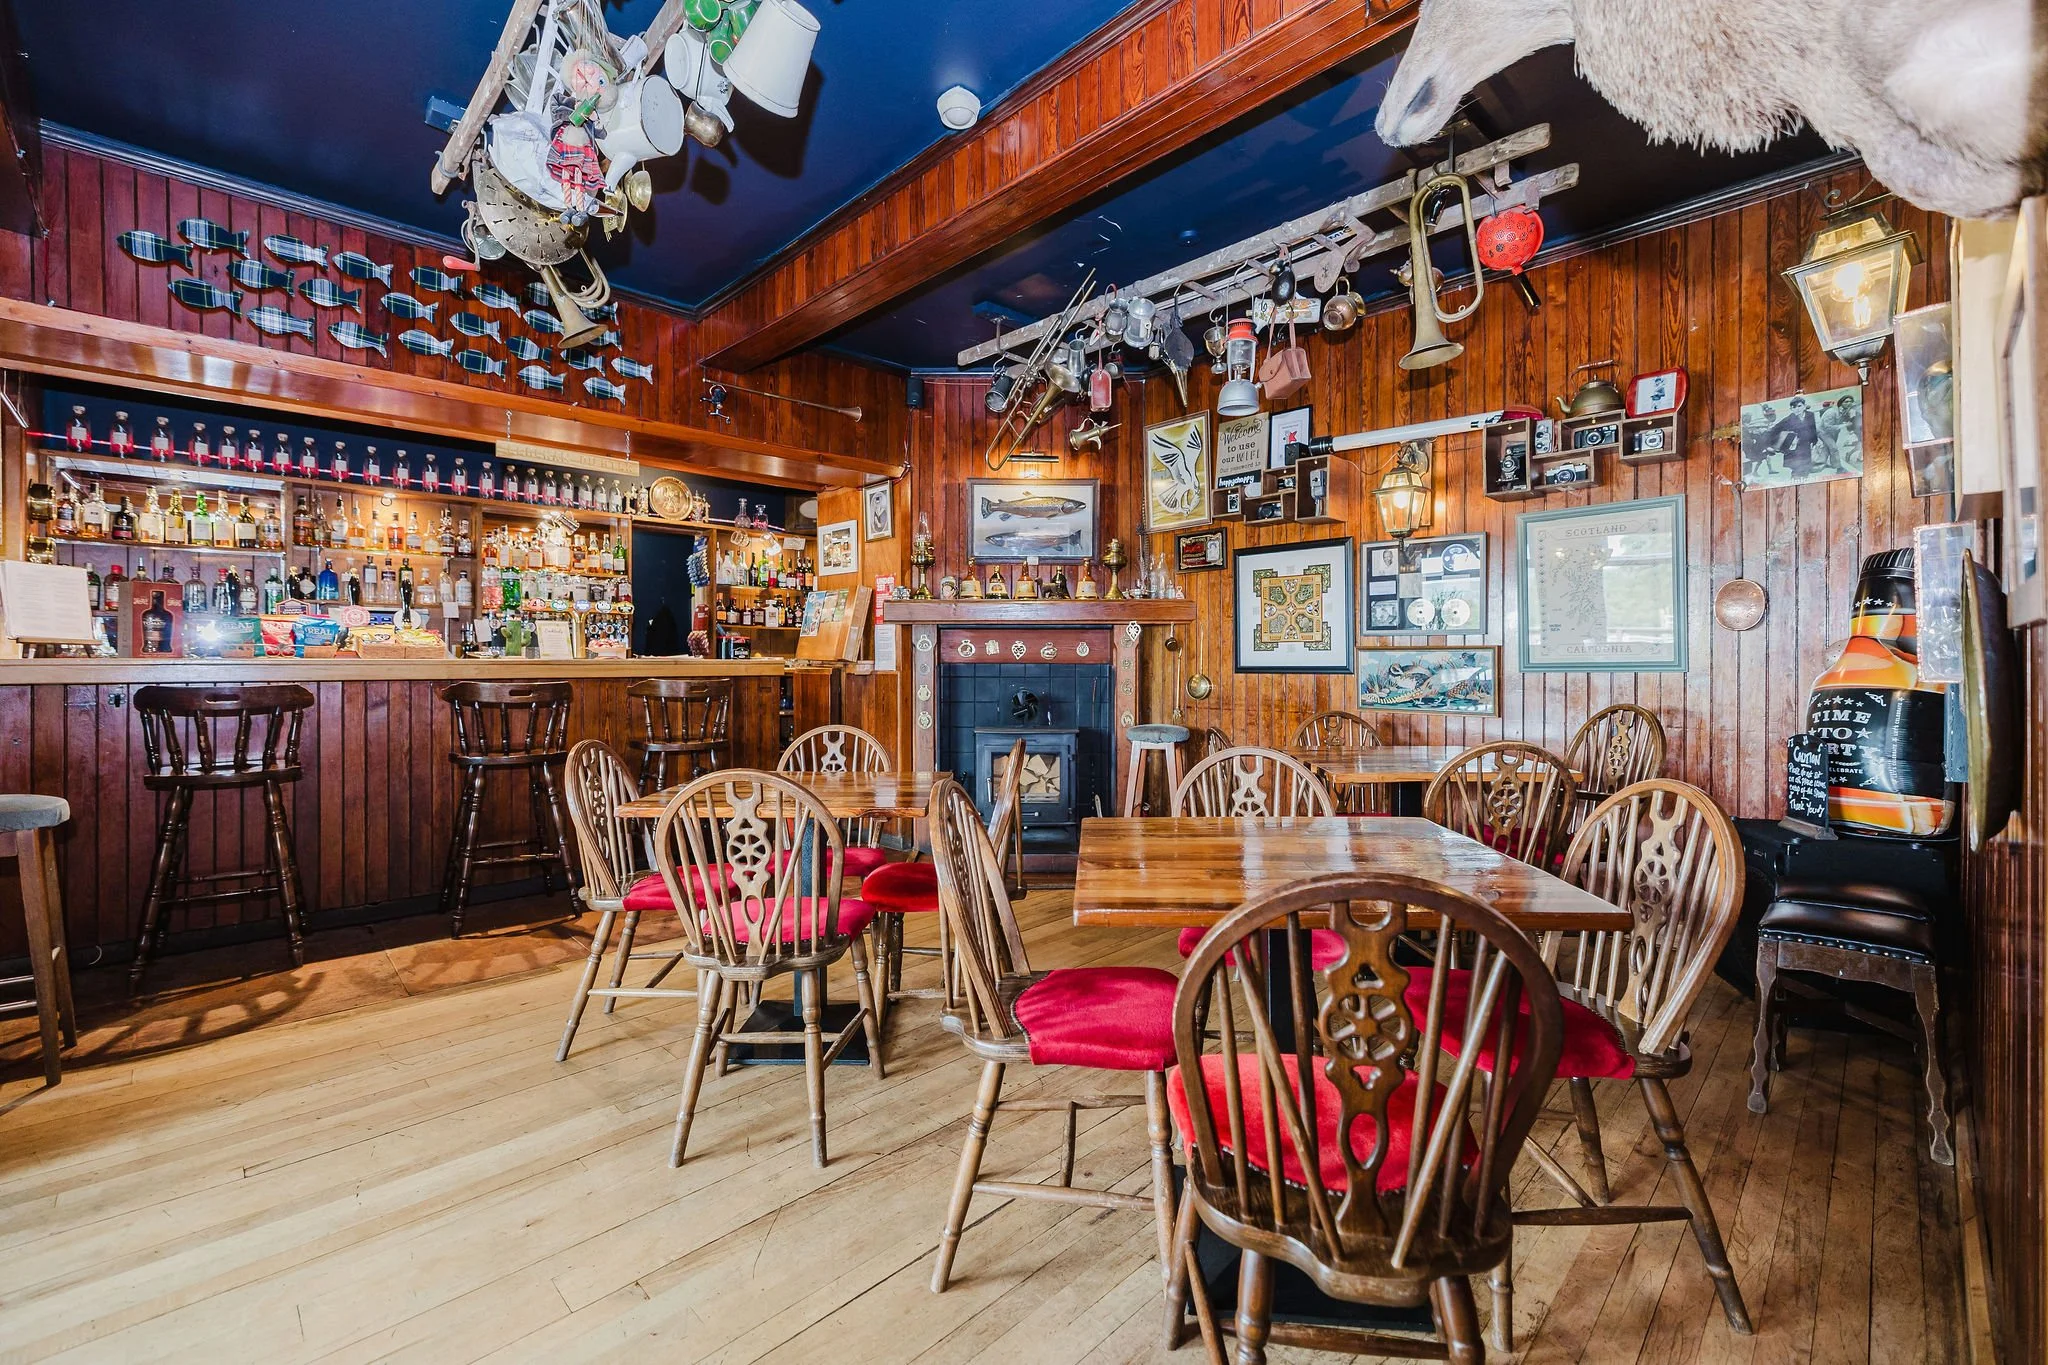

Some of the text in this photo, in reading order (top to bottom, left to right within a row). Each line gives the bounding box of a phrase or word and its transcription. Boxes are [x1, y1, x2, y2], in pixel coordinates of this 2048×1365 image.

[1220, 418, 1263, 446] Welcome
[1239, 441, 1256, 450] use
[1221, 456, 1235, 464] our
[1230, 462, 1253, 471] password
[1566, 524, 1627, 537] SCOTLAND
[308, 626, 332, 636] REAL
[1812, 710, 1871, 724] TIME
[1818, 727, 1853, 739] TO
